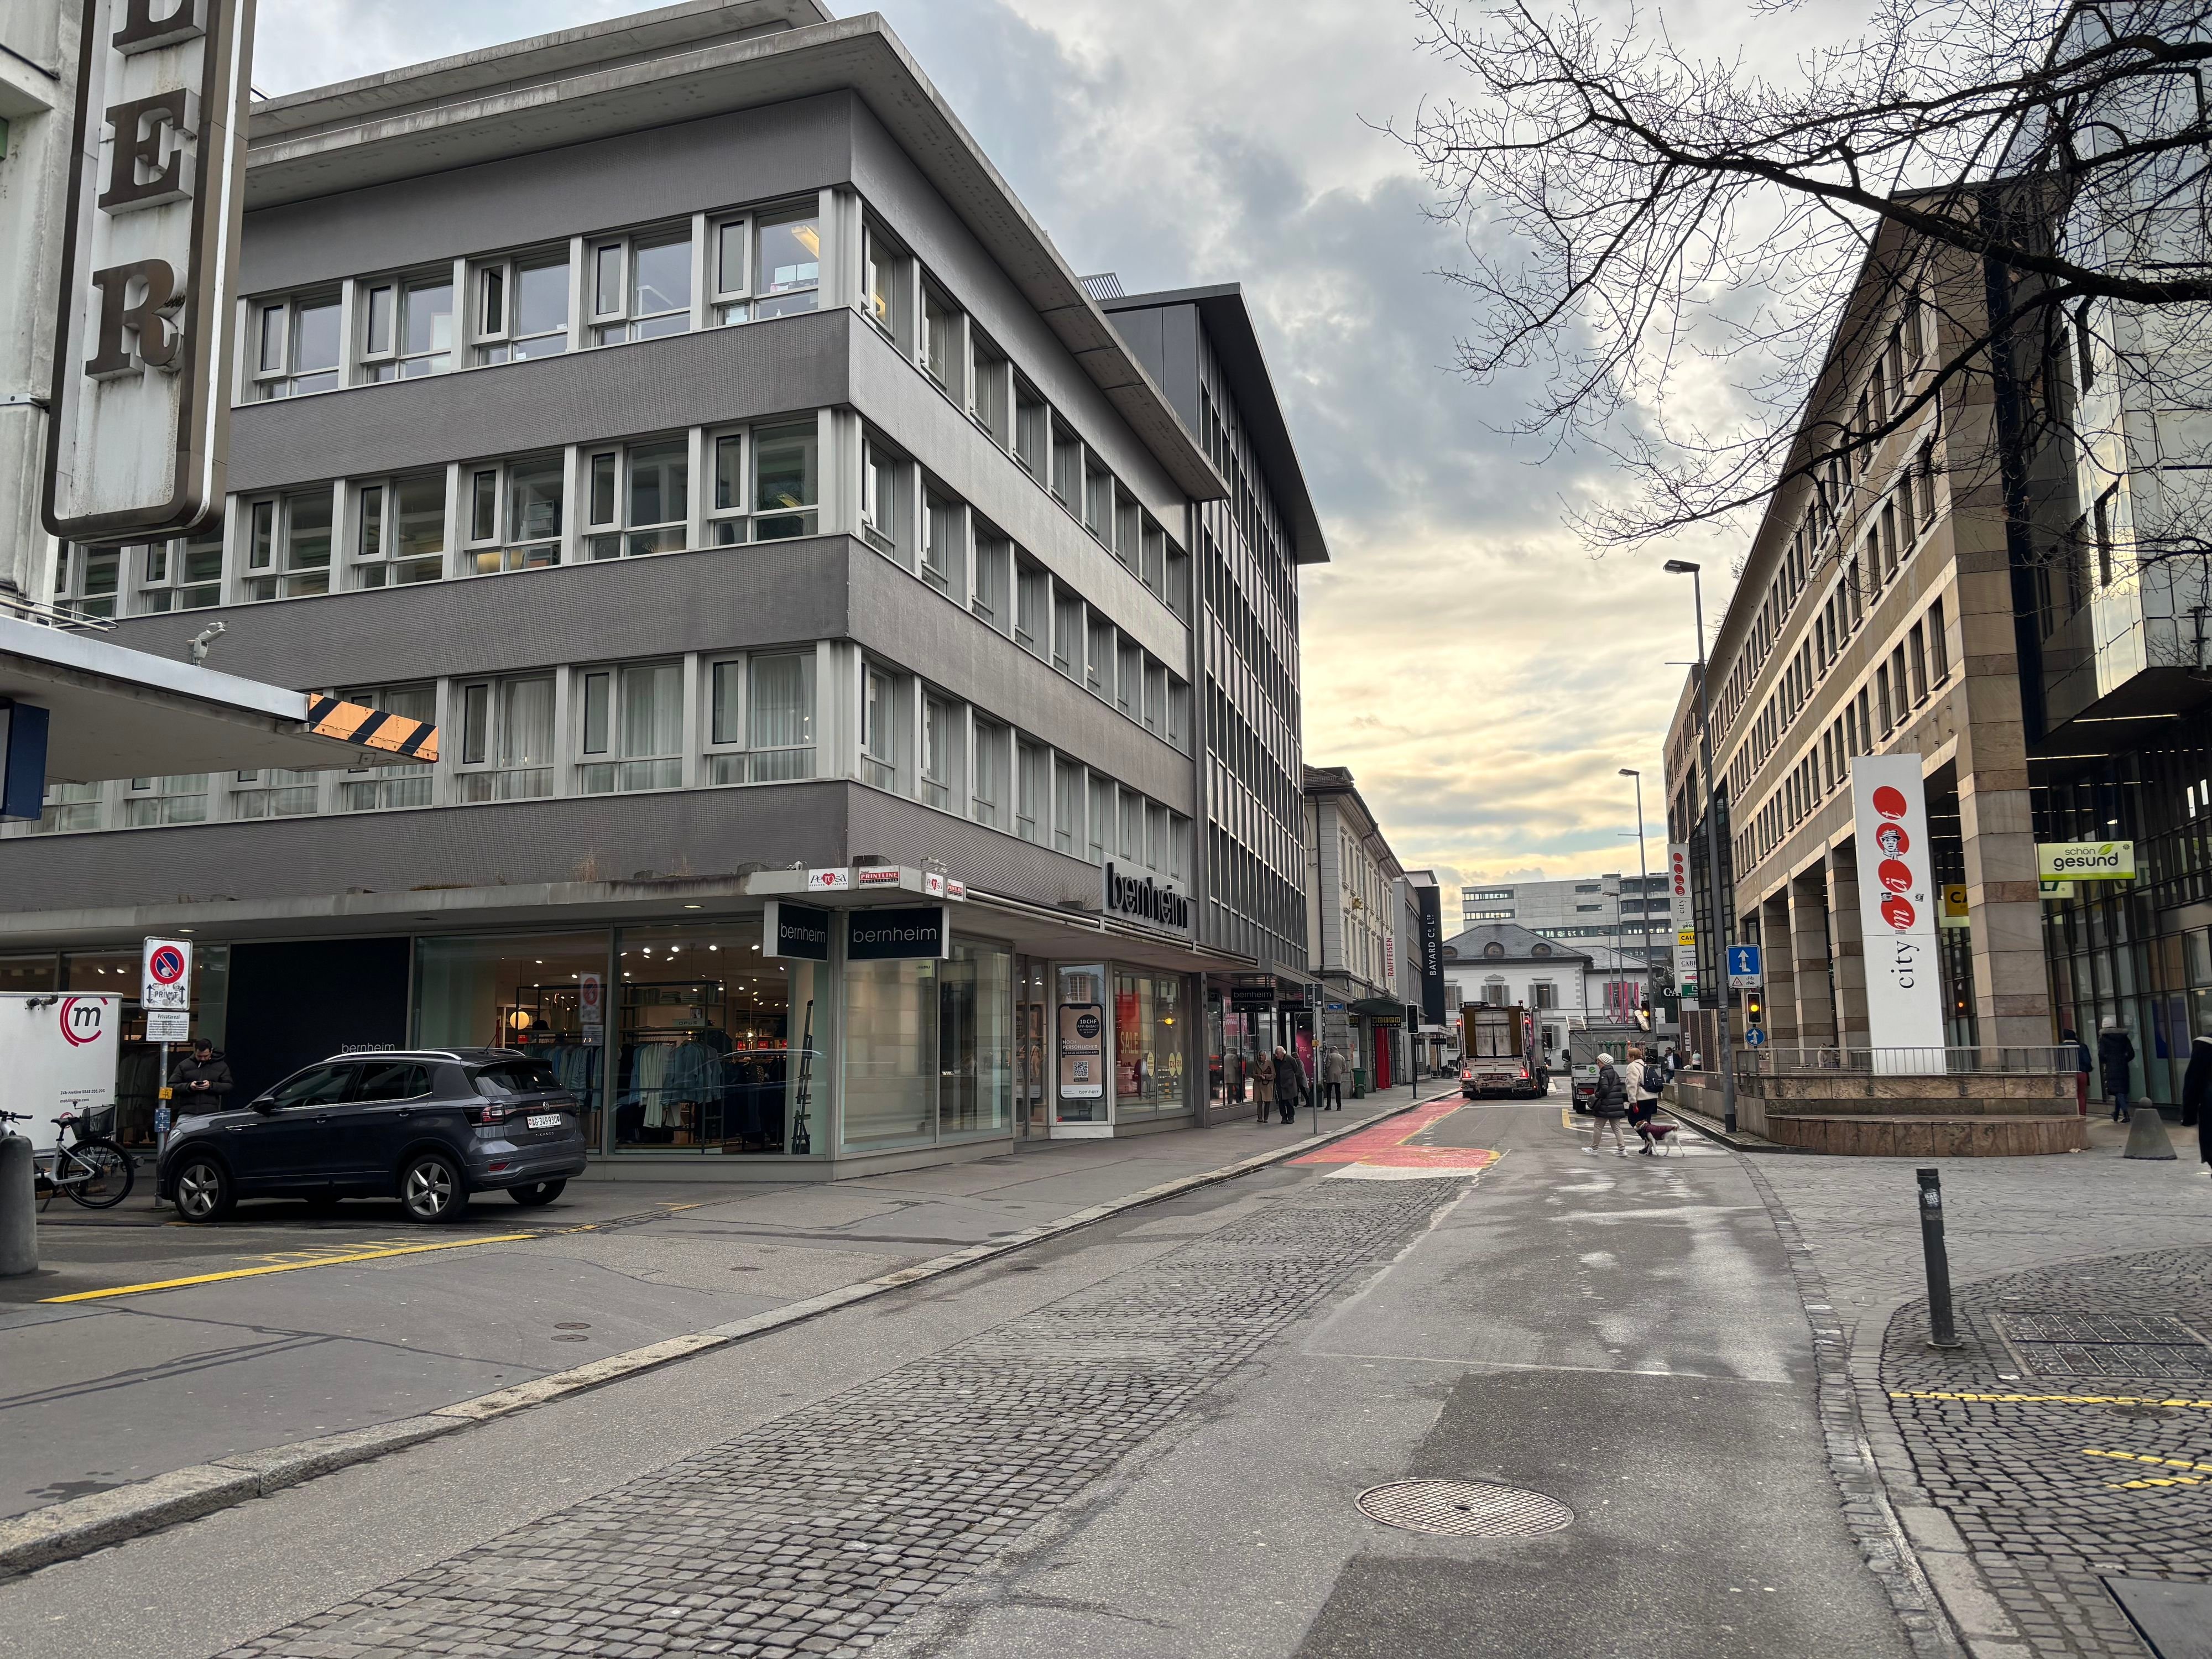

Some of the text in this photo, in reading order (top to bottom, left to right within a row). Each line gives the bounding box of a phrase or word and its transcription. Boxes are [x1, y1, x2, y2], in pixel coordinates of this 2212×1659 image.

[2054, 852, 2119, 871] gesund
[1107, 862, 1188, 928] bernheim
[1677, 899, 1687, 914] city
[781, 923, 826, 943] bernheim
[853, 926, 936, 942] bernheim
[1428, 942, 1437, 975] BAYARD
[1891, 940, 1920, 989] city
[1663, 988, 1679, 997] C&A
[341, 1042, 395, 1053] bernheim
[1120, 1031, 1138, 1054] SALE
